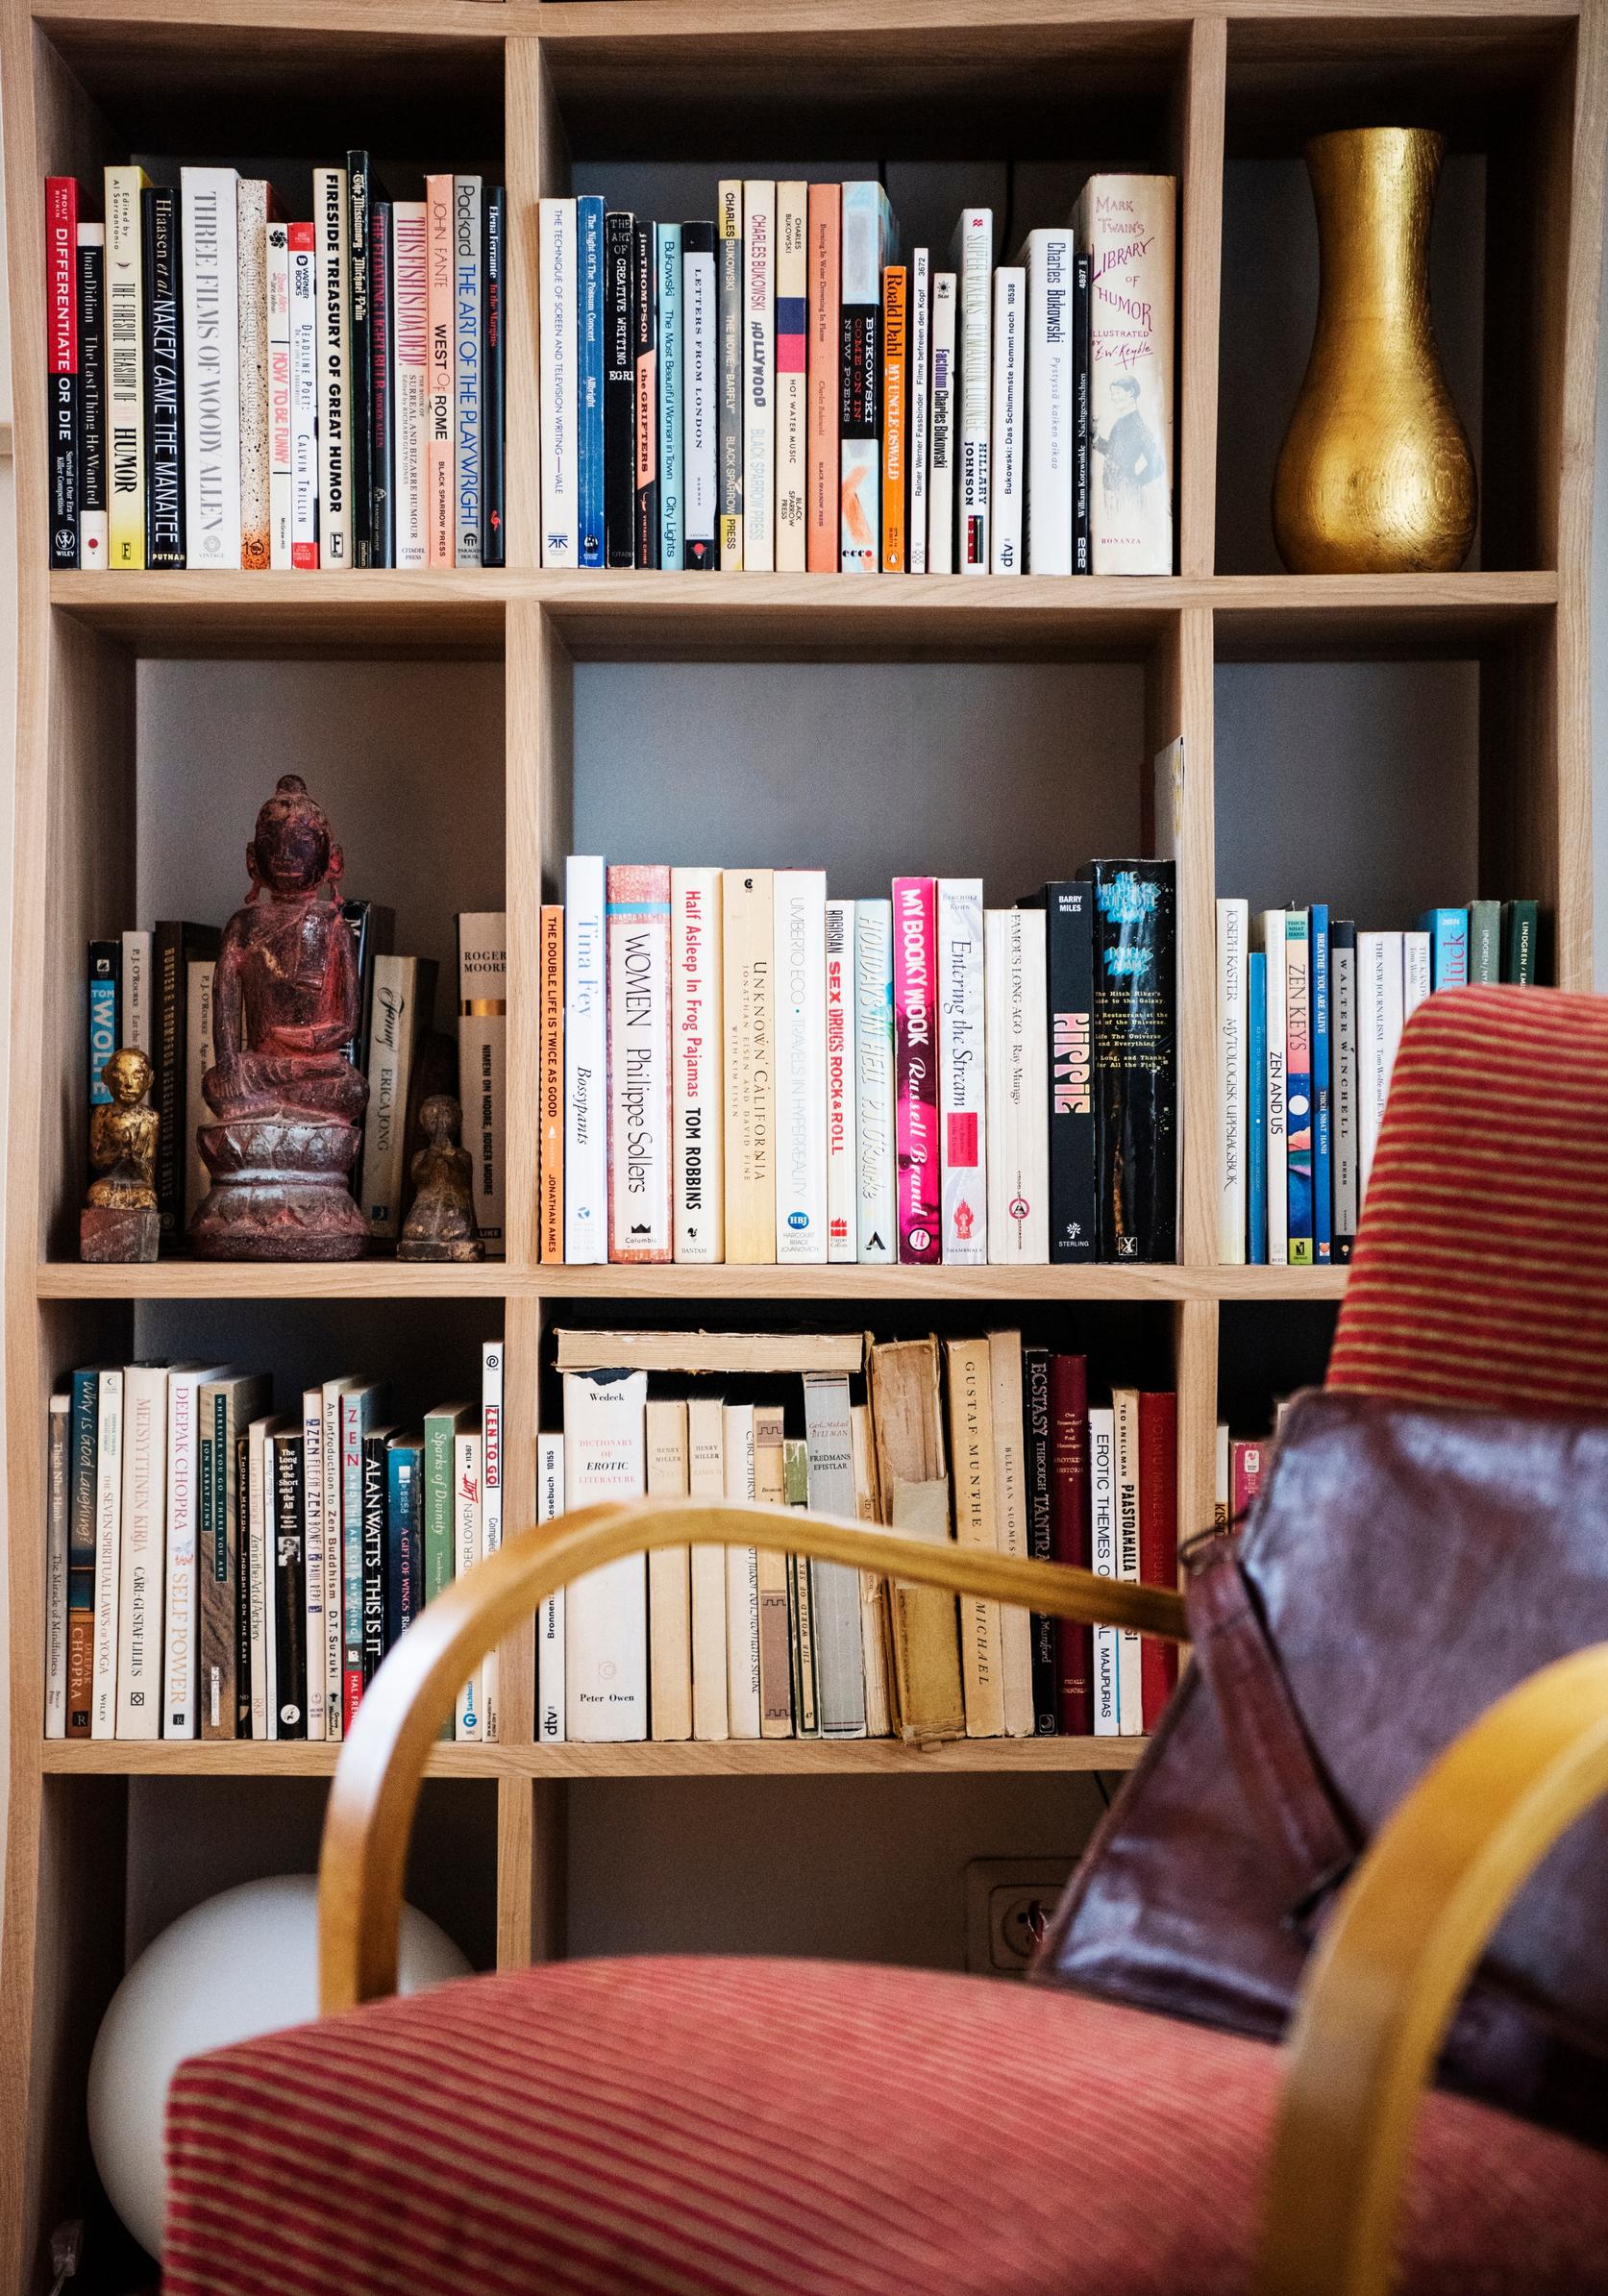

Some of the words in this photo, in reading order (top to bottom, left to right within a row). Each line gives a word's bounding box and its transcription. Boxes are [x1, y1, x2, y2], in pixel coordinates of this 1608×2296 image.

[326, 174, 339, 251] FIRESIDE
[458, 185, 475, 256] Packard
[1096, 197, 1133, 213] MARK
[194, 192, 217, 265] THREE
[1099, 218, 1146, 237] TWAIN'S
[459, 264, 476, 296] THE
[1048, 242, 1066, 284] Charles
[1091, 237, 1154, 284] LIBRARY
[1126, 276, 1140, 288] OF
[56, 229, 70, 370] DIFFERENTIATE
[196, 274, 219, 338] FILMS
[327, 258, 340, 347] TREASURY
[616, 259, 626, 311] CREATIVE
[887, 274, 901, 317] Roald
[154, 300, 177, 359] NAKED
[459, 302, 476, 335] ART
[1047, 289, 1066, 342] Bukowski
[1092, 284, 1152, 332] HUMOR
[198, 347, 220, 371] OF
[435, 324, 447, 370] WEST
[460, 341, 476, 367] OF
[616, 318, 627, 365] WRITING
[887, 322, 901, 357] Dahl
[328, 355, 340, 378] OF
[865, 317, 874, 423] BUKOWSKI
[886, 363, 900, 383] MY
[934, 348, 950, 388] Factotum
[1050, 358, 1060, 399] Pystyssä
[59, 378, 70, 404] OR
[155, 365, 177, 413] CAME
[460, 373, 477, 404] THE
[888, 386, 900, 427] UNCLE
[934, 390, 950, 424] Charles
[59, 410, 71, 440] DIE
[199, 381, 221, 456] WOODY
[329, 384, 341, 439] GREAT
[435, 396, 448, 440] ROME
[1051, 405, 1060, 437] kaiken
[155, 420, 177, 455] THE
[888, 430, 900, 480] OSWALD
[934, 426, 948, 468] Bukowski
[1051, 442, 1060, 469] aikaa
[329, 445, 342, 512] HUMOR
[460, 410, 478, 528] PLAYWRIGHT
[965, 442, 974, 506] JOHNSON
[155, 462, 178, 542] MANATEE
[200, 461, 223, 530] ALLEN
[666, 496, 677, 519] City
[665, 522, 677, 556] Lights
[1002, 544, 1016, 566] dtv
[686, 891, 702, 920] Half
[902, 889, 924, 916] MY
[548, 916, 557, 939] THE
[682, 926, 702, 972] Asleep
[827, 910, 843, 953] BOGOSIAN
[464, 951, 507, 960] ROGER
[464, 963, 507, 973] MOORE
[548, 942, 557, 986] DOUBLE
[902, 920, 926, 984] BOOKY
[625, 933, 652, 1025] WOMEN
[686, 979, 702, 993] In
[829, 961, 841, 1004] SEX
[944, 940, 973, 1015] Entering
[1289, 965, 1305, 1001] ZEN
[548, 990, 557, 1014] LIFE
[548, 1017, 557, 1027] IS
[682, 1000, 702, 1030] Frog
[904, 988, 928, 1047] WOOK
[548, 1030, 557, 1065] TWICE
[829, 1009, 843, 1051] DRUGS
[952, 1019, 971, 1044] the
[1290, 1007, 1307, 1051] KEYS
[548, 1068, 557, 1083] AS
[622, 1048, 652, 1125] Philippe
[683, 1038, 702, 1097] Pajamas
[953, 1049, 971, 1106] Stream
[1270, 1051, 1282, 1080] ZEN
[379, 1069, 393, 1110] ERICA
[548, 1086, 557, 1117] GOOD
[575, 1067, 592, 1145] Bossypants
[908, 1057, 927, 1137] Russell
[1271, 1083, 1283, 1115] AND
[378, 1110, 390, 1150] JONG
[686, 1107, 702, 1139] TOM
[1271, 1116, 1284, 1135] US
[629, 1131, 653, 1193] Sollers
[686, 1147, 702, 1210] ROBBINS
[908, 1143, 927, 1216] Brand
[175, 1388, 188, 1452] DEEPAK
[965, 1362, 978, 1435] GUSTAF
[1031, 1362, 1048, 1435] ECSTASY
[486, 1409, 498, 1439] ZEN
[433, 1433, 446, 1469] Sparks
[486, 1444, 498, 1461] TO
[586, 1462, 630, 1470] EROTIC
[1036, 1442, 1046, 1491] THROUGH
[1097, 1434, 1109, 1490] EROTIC
[175, 1458, 188, 1530] CHOPRA
[366, 1459, 381, 1507] ALAN
[433, 1473, 447, 1487] of
[486, 1465, 498, 1485] GO
[968, 1444, 981, 1527] MUNTHE
[433, 1490, 447, 1535] Divinity
[1098, 1498, 1110, 1559] THEMES
[1122, 1485, 1136, 1571] PAASTOAMALLA
[366, 1508, 381, 1567] WATTS
[53, 1554, 62, 1571] The
[52, 1574, 62, 1604] Miracle
[133, 1567, 144, 1640] CARL-GUSTAF
[172, 1573, 186, 1620] SELF
[366, 1575, 381, 1615] THIS
[52, 1610, 61, 1619] of
[366, 1618, 381, 1633] IS
[51, 1621, 61, 1676] Mindfulness
[71, 1627, 83, 1699] CHOPRA
[132, 1641, 142, 1677] LILIUS
[366, 1639, 381, 1655] IT
[975, 1601, 989, 1686] MICHAEL
[171, 1628, 185, 1703] POWER
[1101, 1648, 1111, 1717] MAJUPURIAS
[545, 1712, 559, 1735] dtv
